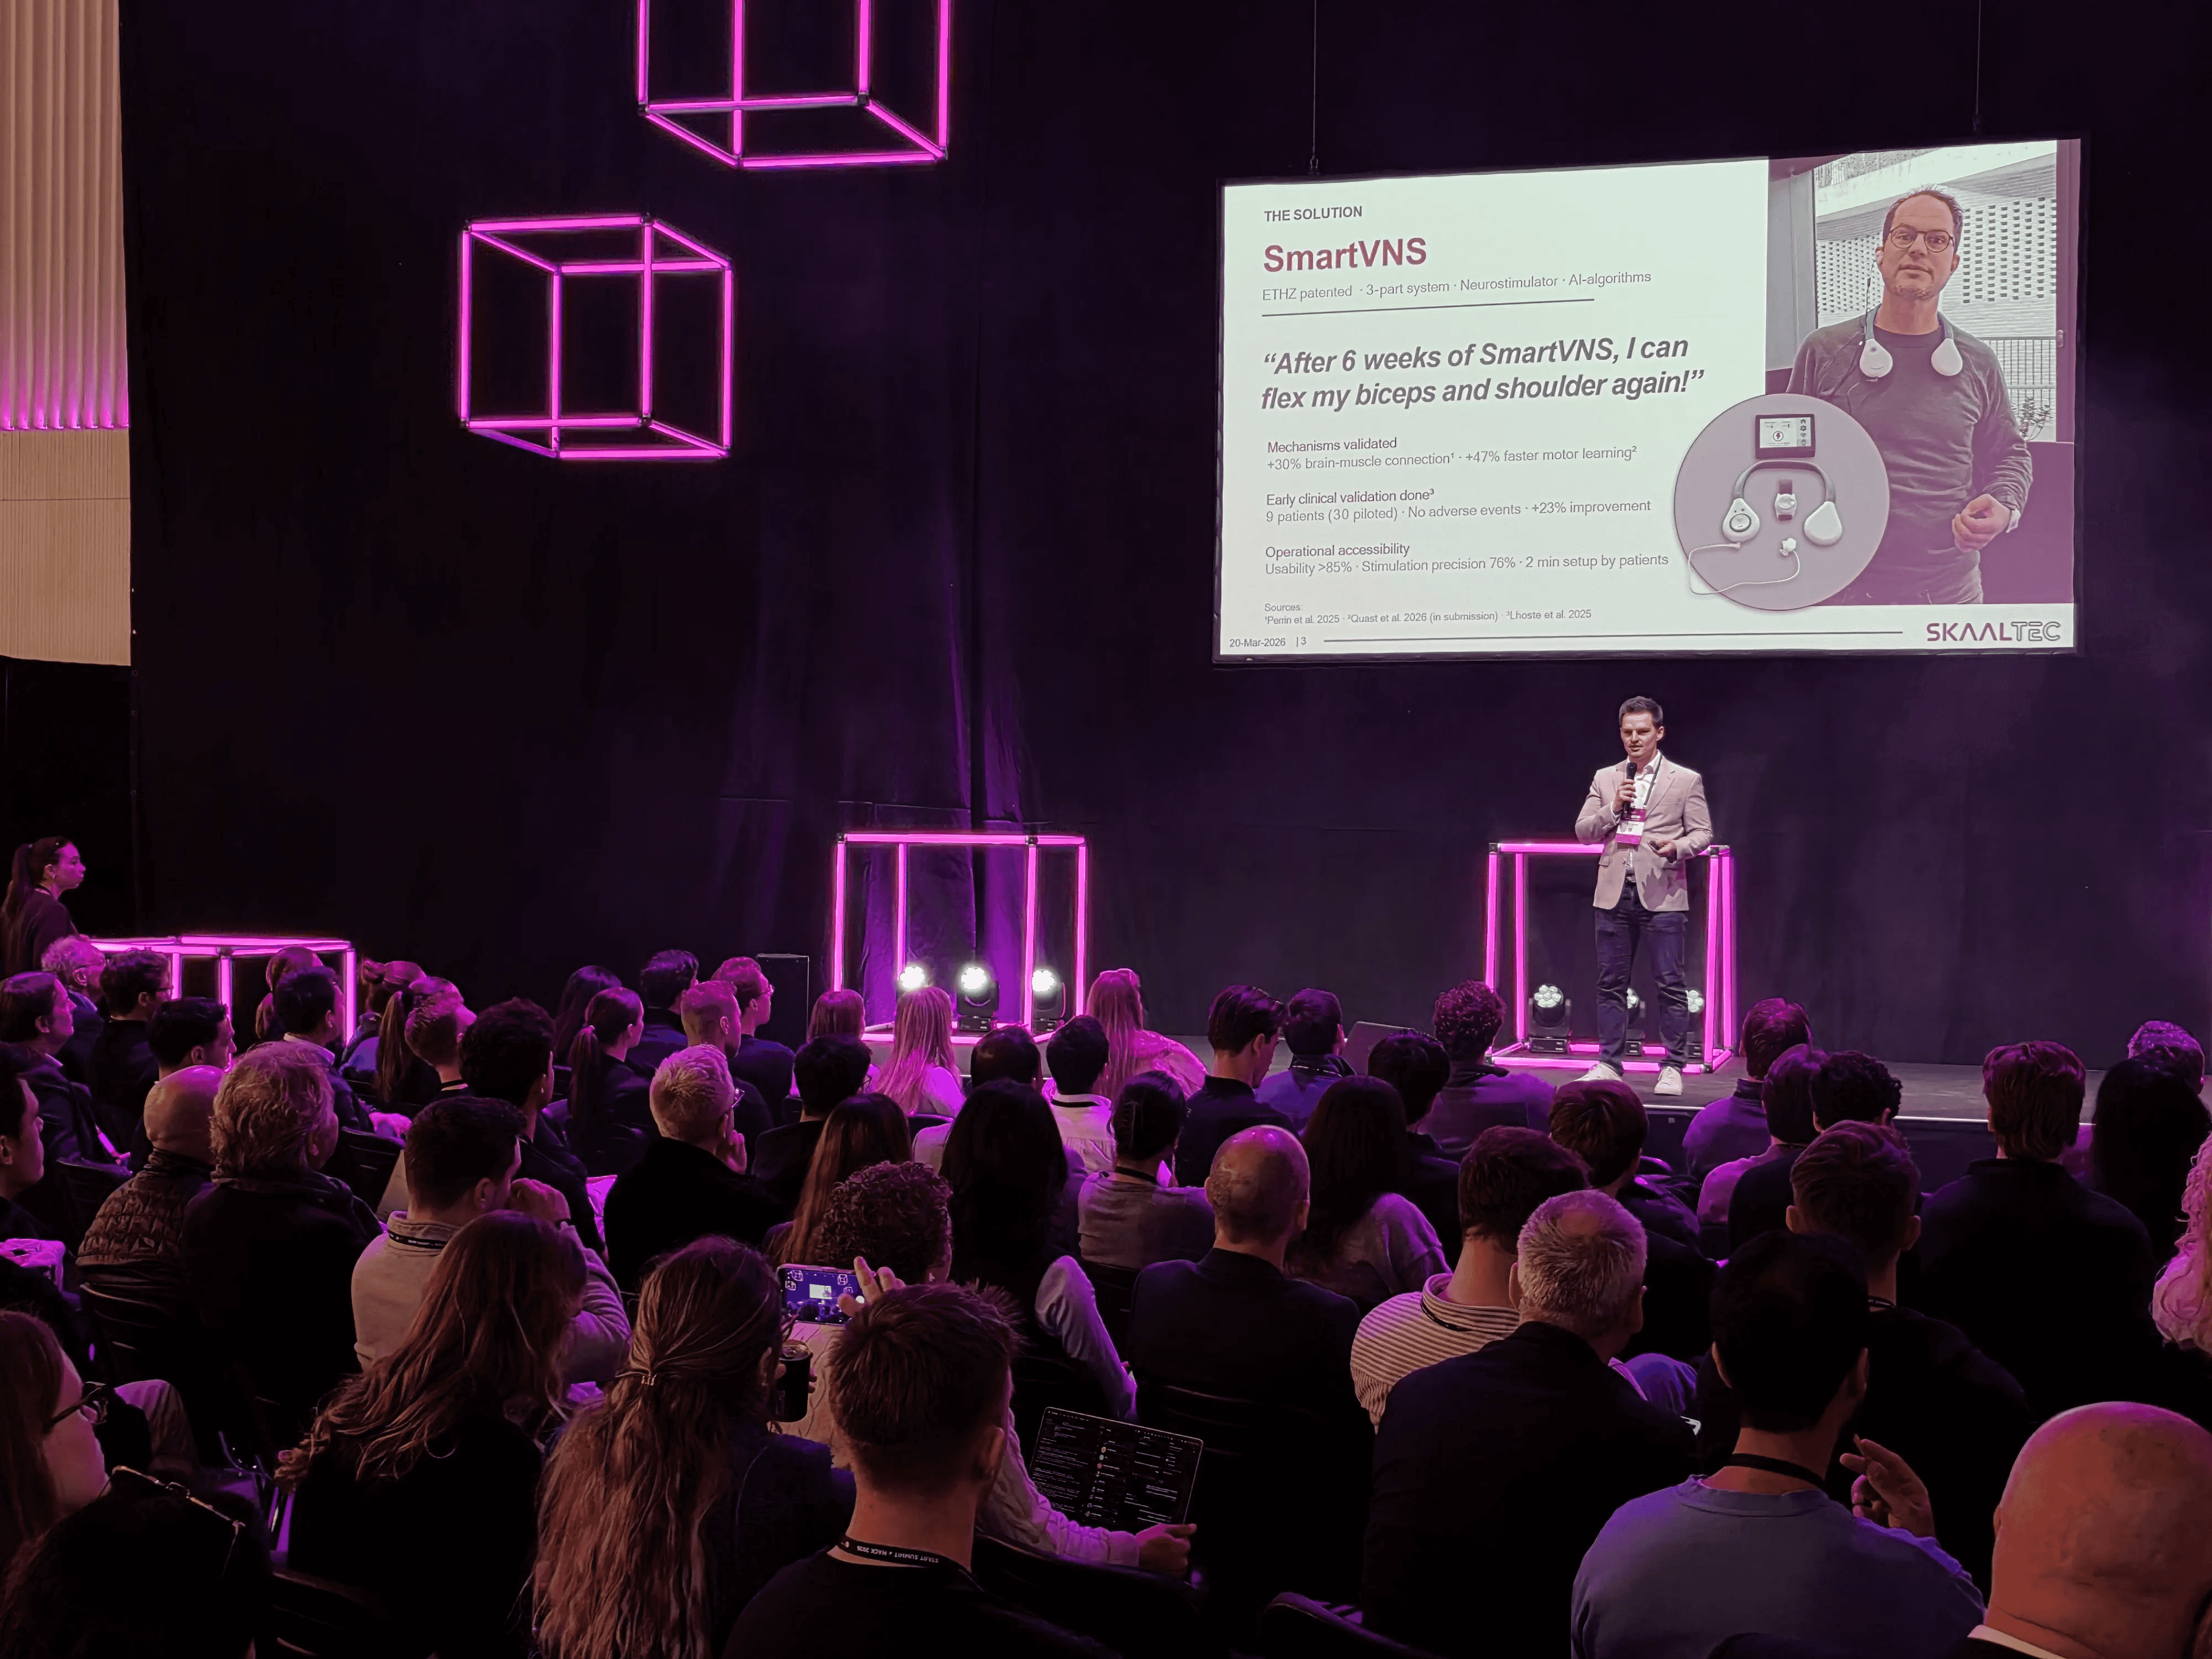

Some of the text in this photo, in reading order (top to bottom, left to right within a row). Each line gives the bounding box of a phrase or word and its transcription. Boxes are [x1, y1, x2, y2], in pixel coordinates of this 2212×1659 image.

[1264, 205, 1363, 223] THE SOLUTION
[1263, 237, 1427, 273] SmartVNS
[1262, 287, 1297, 301] ETHZ
[1300, 284, 1352, 303] patented
[1366, 283, 1404, 299] 3-part
[1406, 282, 1449, 297] system
[1460, 275, 1559, 291] Neurostimulator
[1568, 271, 1651, 289] AI-algorithms
[1342, 349, 1357, 372] 6
[1364, 346, 1442, 371] weeks
[1447, 342, 1477, 368] of
[1479, 337, 1619, 366] SmartVNS,
[1626, 336, 1636, 359] I
[1640, 339, 1689, 359] can
[1261, 386, 1308, 410] flex
[1311, 389, 1352, 411] my
[1354, 382, 1437, 408] biceps
[1442, 377, 1492, 403] and
[1494, 373, 1609, 400] shoulder
[1267, 436, 1397, 453] Mechanisms validated
[1267, 457, 1301, 471] +30%
[1305, 455, 1382, 469] brain-muscle
[1465, 450, 1500, 463] +47%
[1504, 449, 1540, 462] faster
[1542, 448, 1579, 461] motor
[1266, 493, 1296, 509] Early
[1298, 491, 1337, 505] clinical
[1340, 489, 1397, 503] validation
[1266, 510, 1274, 523] 9
[1277, 509, 1325, 526] patients
[1328, 508, 1349, 525] (30
[1353, 506, 1397, 524] piloted)
[1408, 505, 1426, 519] No
[1428, 504, 1478, 518] adverse
[1480, 504, 1521, 516] events
[1531, 501, 1567, 514] +23%
[1570, 500, 1651, 517] improvement
[1265, 541, 1410, 561] Operational accessibility
[1265, 561, 1316, 577] Usability
[1318, 561, 1352, 574] >85%
[1361, 559, 1428, 572] Stimulation
[1432, 557, 1486, 575] precision
[1489, 556, 1516, 569] 76%
[1525, 555, 1533, 568] 2
[1537, 556, 1559, 568] min
[1563, 556, 1598, 571] setup
[1601, 554, 1616, 570] by
[1619, 552, 1669, 569] patients
[1264, 602, 1303, 612] Sources:
[1293, 616, 1303, 624] et
[1305, 614, 1315, 624] al.
[1317, 614, 1340, 624] 2025
[1380, 614, 1389, 623] et
[1391, 613, 1401, 622] al.
[1404, 612, 1427, 622] 2026
[1430, 612, 1441, 624] (in
[1443, 611, 1498, 622] submission)
[1544, 611, 1553, 619] et
[1556, 609, 1566, 619] al.
[1568, 608, 1592, 619] 2025
[1926, 621, 2062, 641] SKAALTEC
[1229, 637, 1286, 648] 20-Mar-2026
